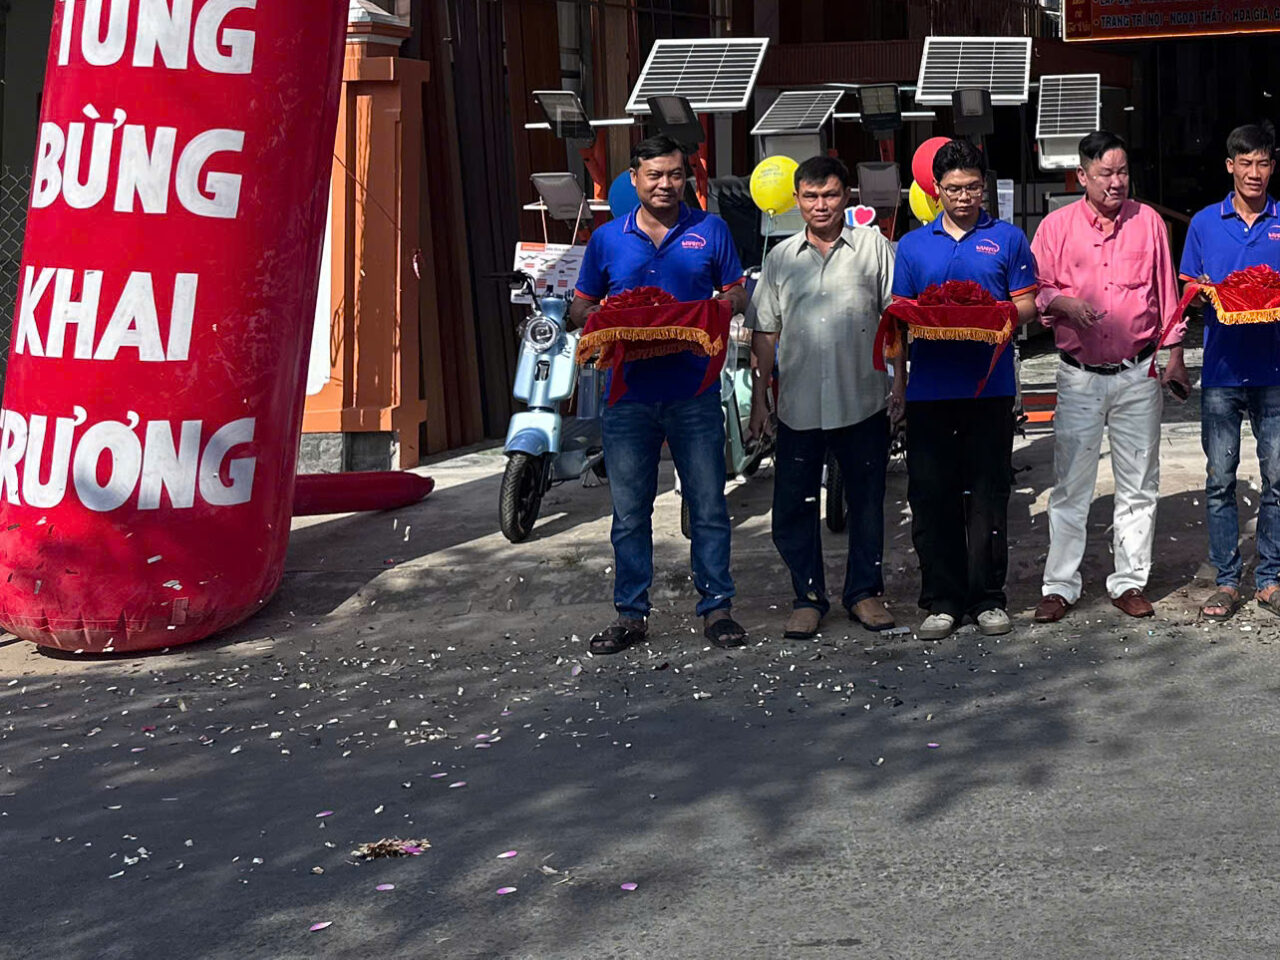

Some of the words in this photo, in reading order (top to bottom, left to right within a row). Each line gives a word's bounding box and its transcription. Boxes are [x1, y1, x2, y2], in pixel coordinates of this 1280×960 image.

[31, 103, 246, 219] BỪNG
[15, 266, 199, 362] KHAI
[0, 404, 257, 512] RƯƠNG
